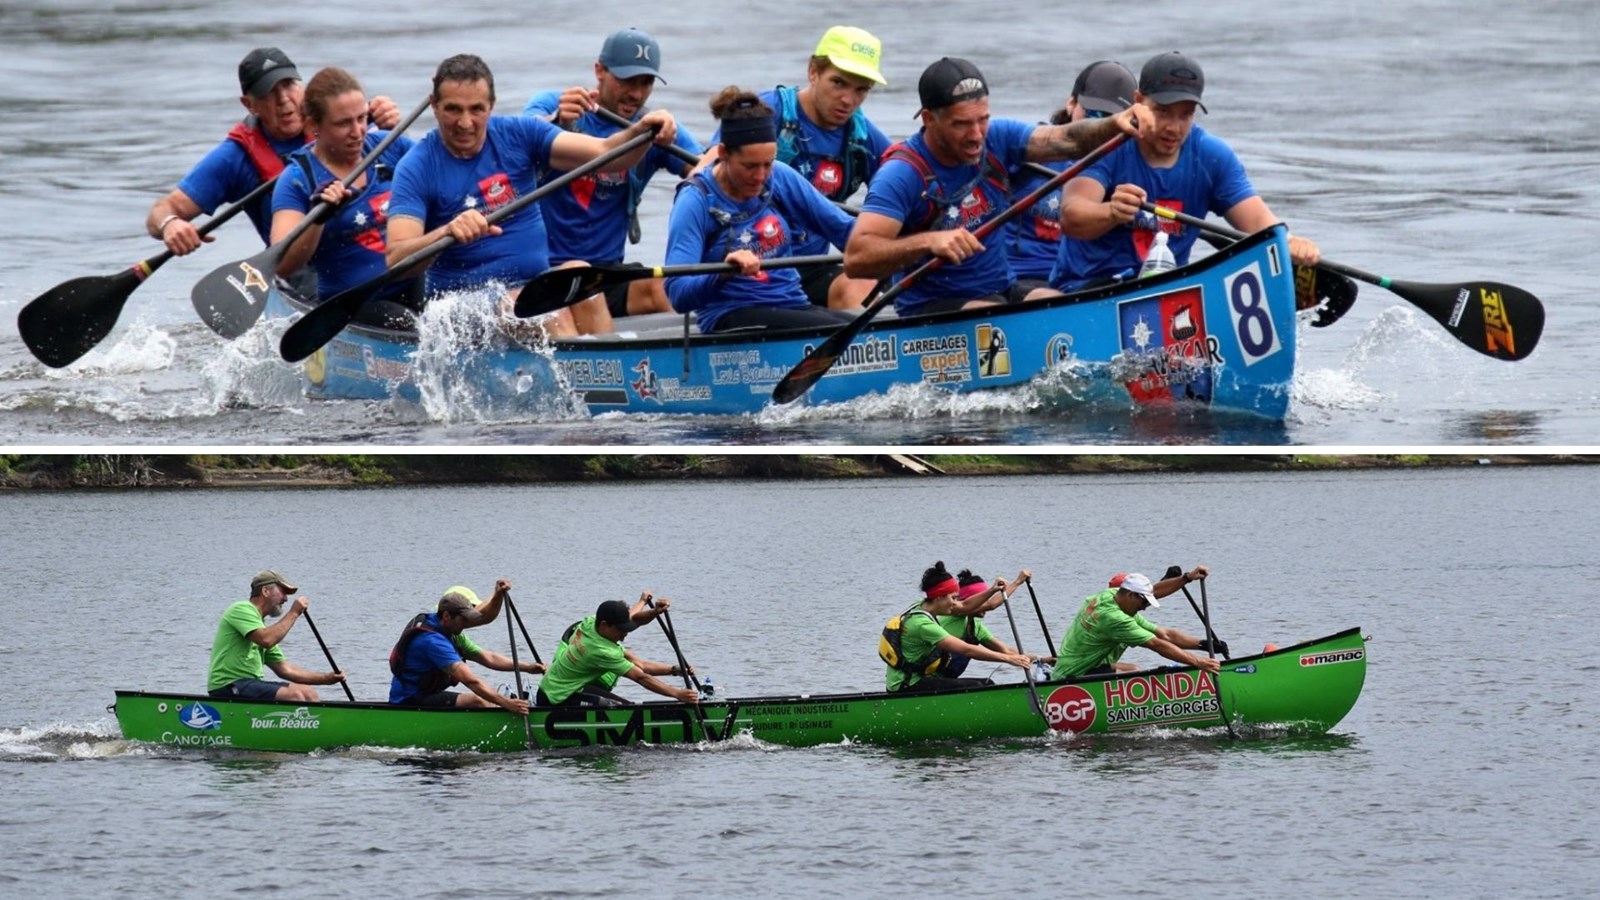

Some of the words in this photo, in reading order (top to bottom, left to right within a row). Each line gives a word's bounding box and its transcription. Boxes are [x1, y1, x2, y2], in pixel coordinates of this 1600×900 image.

[1268, 245, 1280, 275] 1
[1230, 271, 1274, 358] 8
[902, 335, 968, 355] CARRELAGES
[921, 350, 969, 374] expert
[1315, 651, 1363, 664] manac
[1104, 670, 1217, 708] HONDA
[251, 717, 274, 729] Tour
[279, 717, 320, 729] Beauce
[1046, 698, 1095, 724] BGP
[1107, 698, 1219, 724] SAINT-GEORGES
